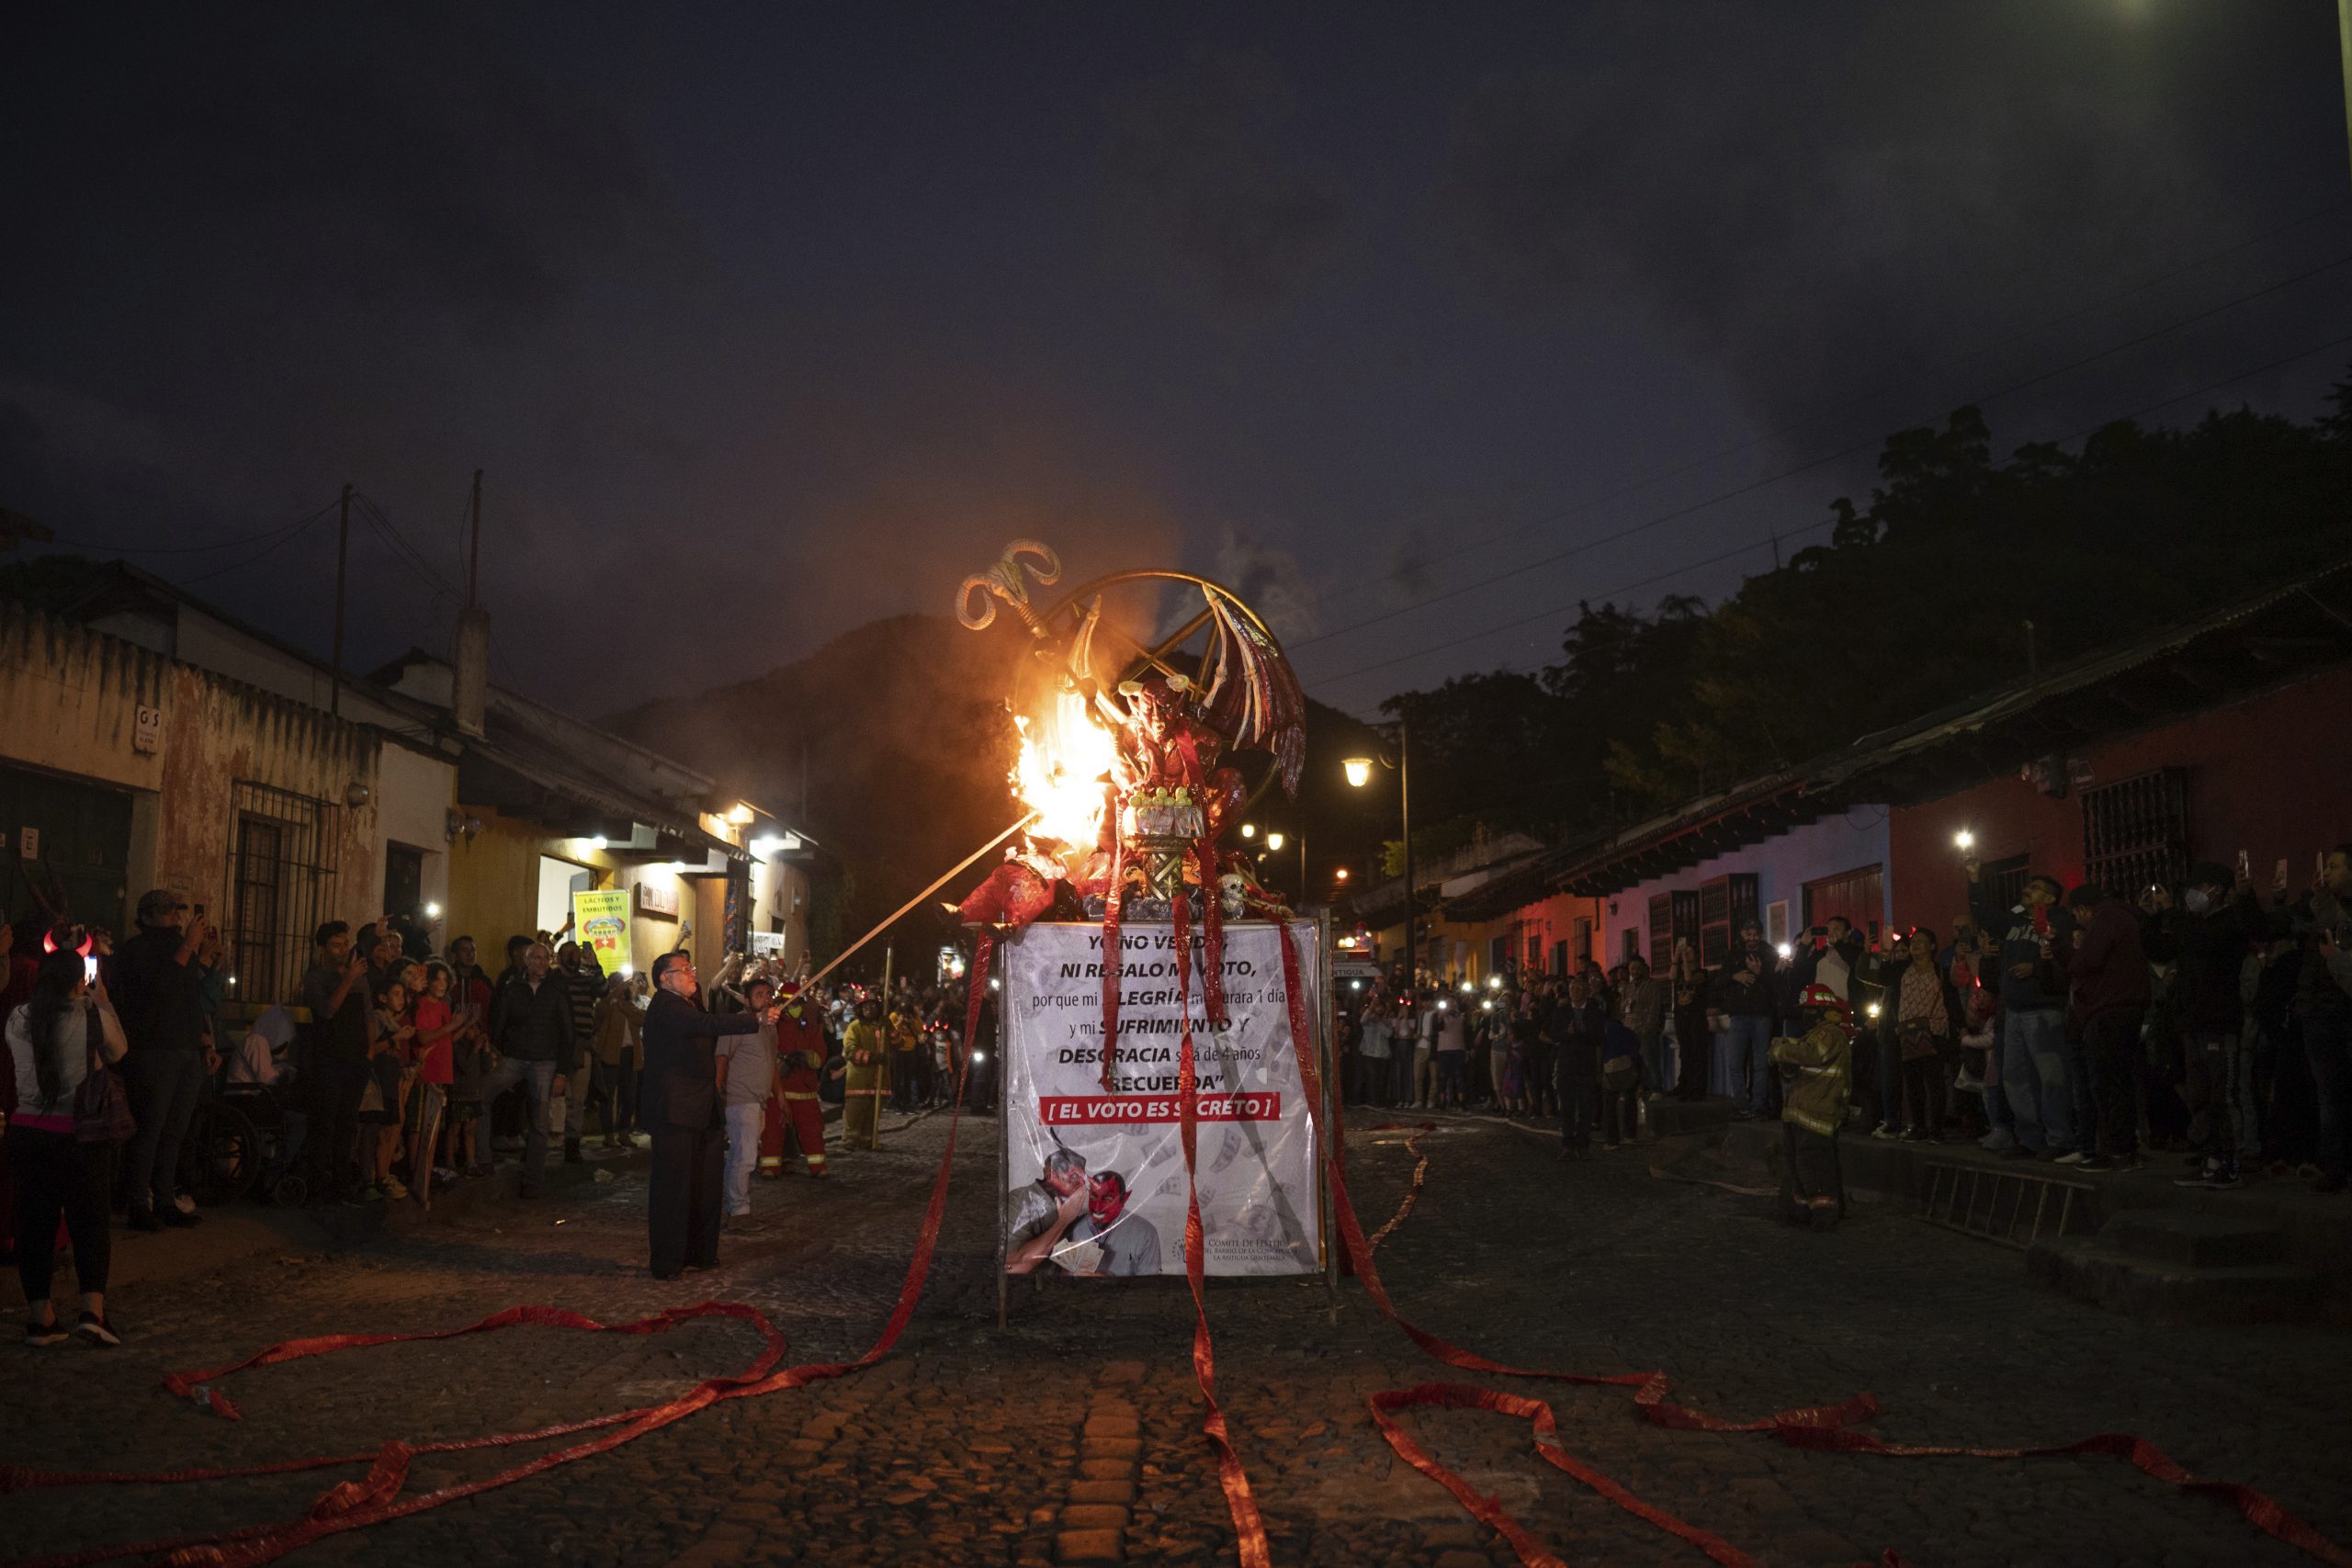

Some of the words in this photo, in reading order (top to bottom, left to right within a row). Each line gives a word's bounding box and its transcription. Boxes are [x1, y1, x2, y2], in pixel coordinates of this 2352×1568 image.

[1088, 935, 1111, 950] Y
[1118, 935, 1148, 950] NO
[1154, 935, 1227, 950] VED,
[1060, 964, 1080, 978] NI
[1168, 963, 1193, 977] M
[1033, 995, 1053, 1009] por
[1056, 994, 1079, 1010] que
[1082, 992, 1098, 1006] mi
[1102, 987, 1188, 1006] LEGRÍA
[1216, 992, 1253, 1004] urara
[1258, 990, 1263, 1003] 1
[1267, 988, 1285, 1003] día
[1069, 1024, 1076, 1039] y
[1080, 1021, 1095, 1035] mi
[1238, 1018, 1250, 1032] Y
[1204, 1046, 1218, 1062] de
[1222, 1045, 1230, 1061] 4
[1233, 1047, 1261, 1061] años
[1059, 1102, 1082, 1119] EL
[1087, 1100, 1142, 1118] VOTO
[1146, 1101, 1170, 1117] ES
[1172, 1100, 1261, 1118] SCRETO
